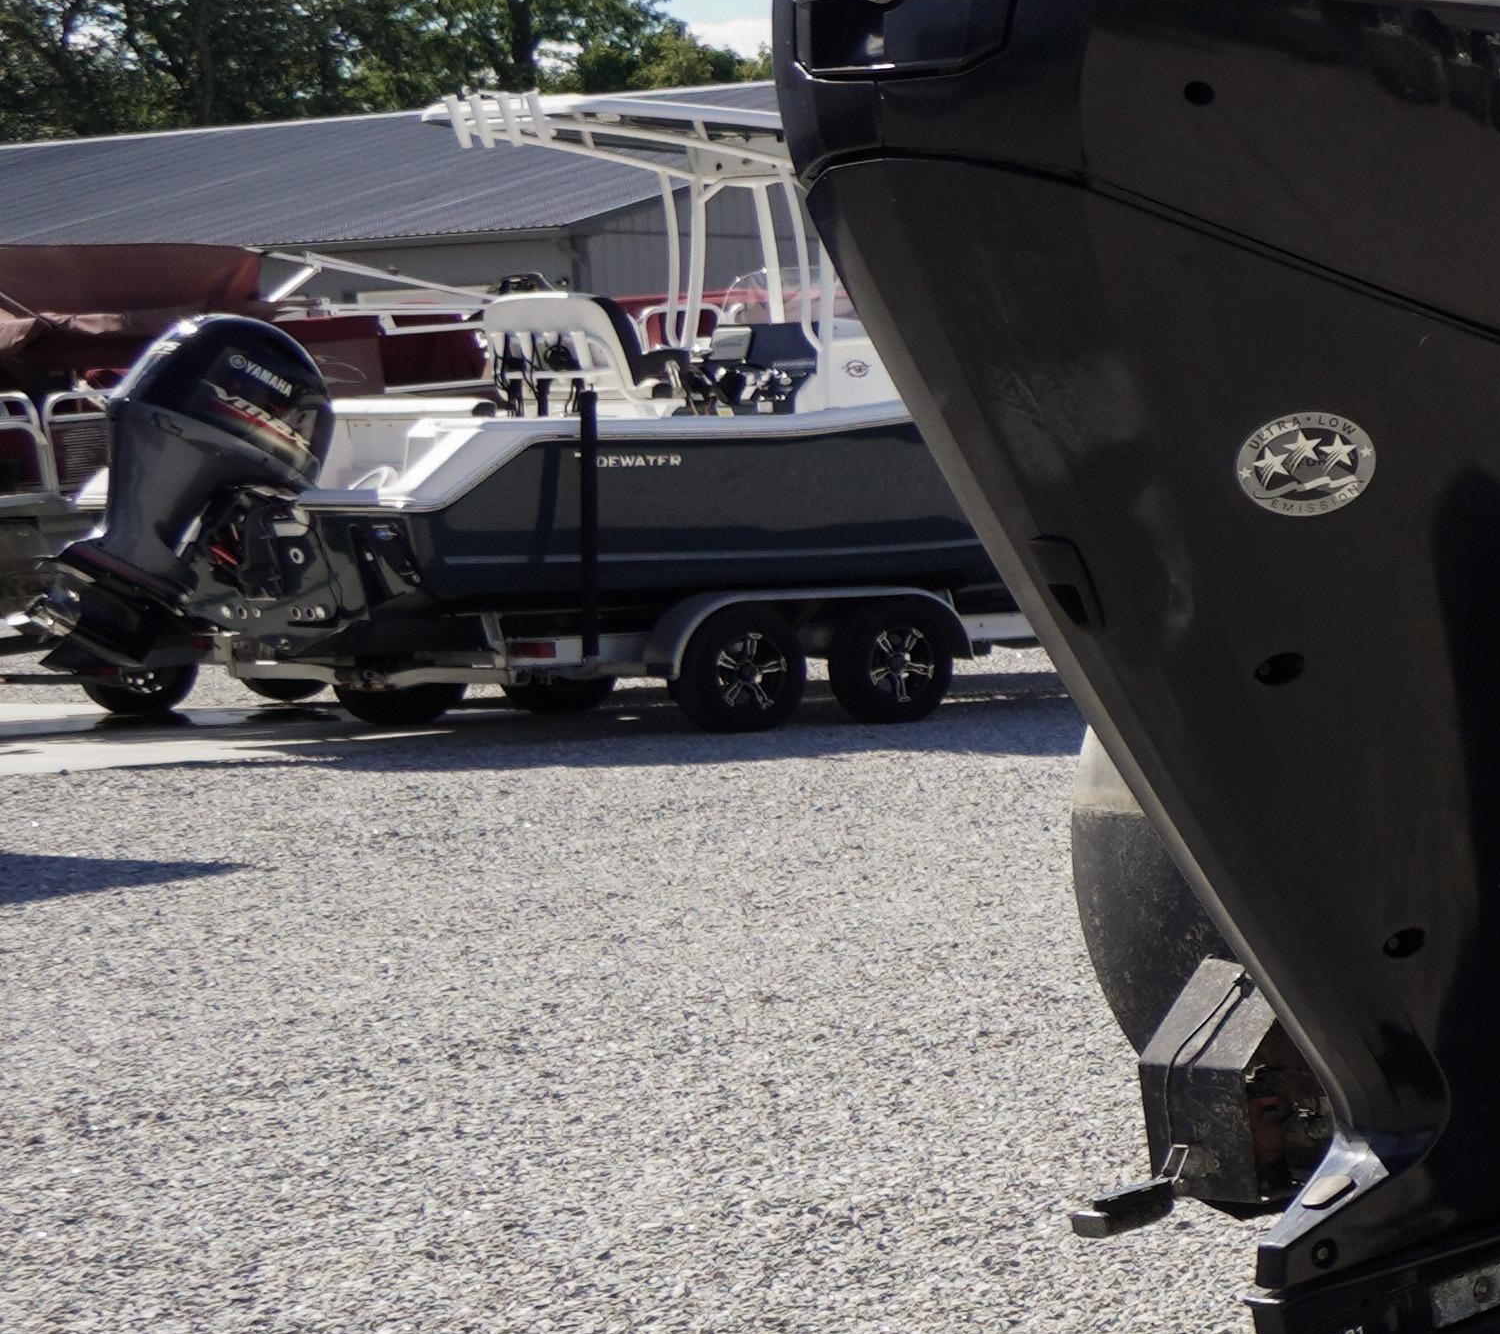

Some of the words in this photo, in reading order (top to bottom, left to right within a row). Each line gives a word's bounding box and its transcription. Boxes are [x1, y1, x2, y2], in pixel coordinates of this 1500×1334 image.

[244, 361, 293, 398] YAMAHA
[1248, 417, 1301, 450] ULTRA
[1318, 414, 1357, 436] LOW
[573, 451, 682, 468] TDEWATER
[1270, 482, 1361, 513] EMISSION
